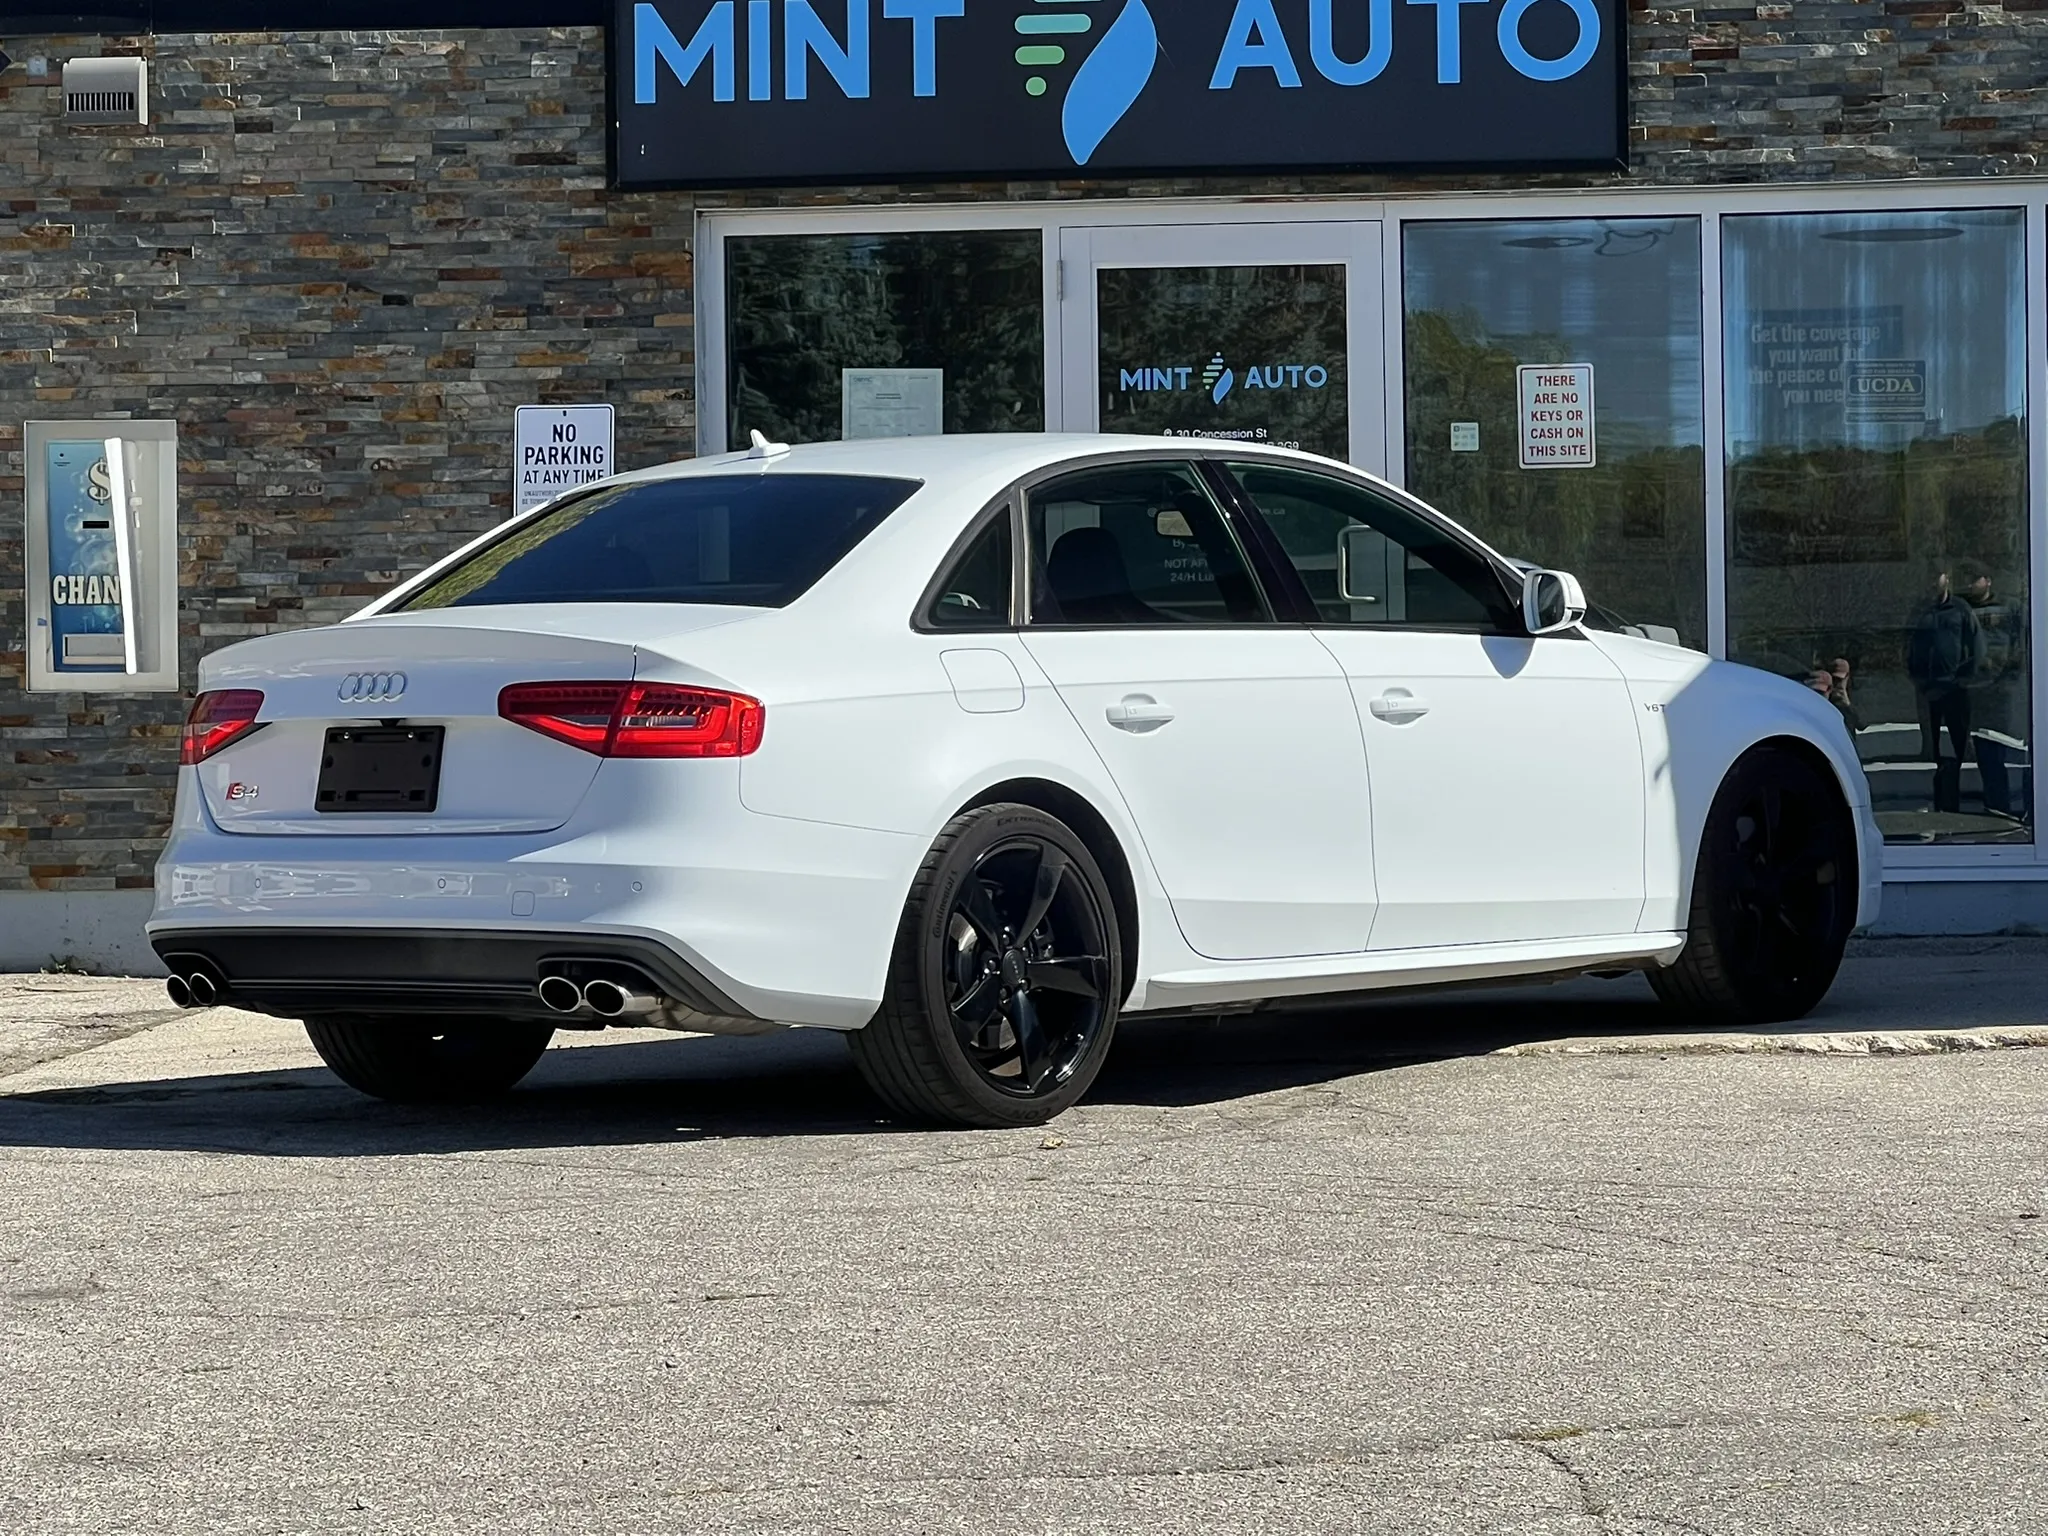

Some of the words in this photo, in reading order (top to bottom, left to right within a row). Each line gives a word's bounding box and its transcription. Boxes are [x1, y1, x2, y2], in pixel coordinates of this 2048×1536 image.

[634, 0, 965, 104] MINT
[1208, 0, 1600, 89] AUTO
[1751, 324, 1778, 344] Get
[1782, 324, 1807, 343] the
[1810, 325, 1881, 346] coverage
[1769, 348, 1797, 368] you
[1799, 346, 1840, 363] want
[1120, 367, 1192, 391] MINT
[1245, 365, 1328, 389] AUTO
[1536, 375, 1576, 387] THERE
[1777, 368, 1825, 388] peace
[1857, 378, 1915, 393] UCDA
[1534, 393, 1557, 404] ARE
[1561, 392, 1578, 403] NO
[1782, 388, 1810, 408] you
[1813, 388, 1844, 404] nee
[1531, 410, 1562, 421] KEYS
[1566, 410, 1583, 420] OR
[552, 424, 576, 442] NO
[1176, 429, 1189, 437] 30
[1192, 429, 1253, 440] Concession
[1256, 428, 1267, 438] St
[1530, 428, 1562, 439] CASH
[1567, 427, 1584, 438] ON
[524, 446, 604, 465] PARKING
[1529, 445, 1556, 457] THIS
[1560, 445, 1586, 456] SITE
[523, 470, 539, 484] AT
[542, 470, 569, 483] ANY
[573, 469, 604, 483] TIME
[1164, 558, 1188, 569] NOT
[1170, 572, 1196, 582] 24/H
[52, 574, 121, 605] CHAN
[229, 782, 259, 799] S4
[932, 876, 956, 939] Continental
